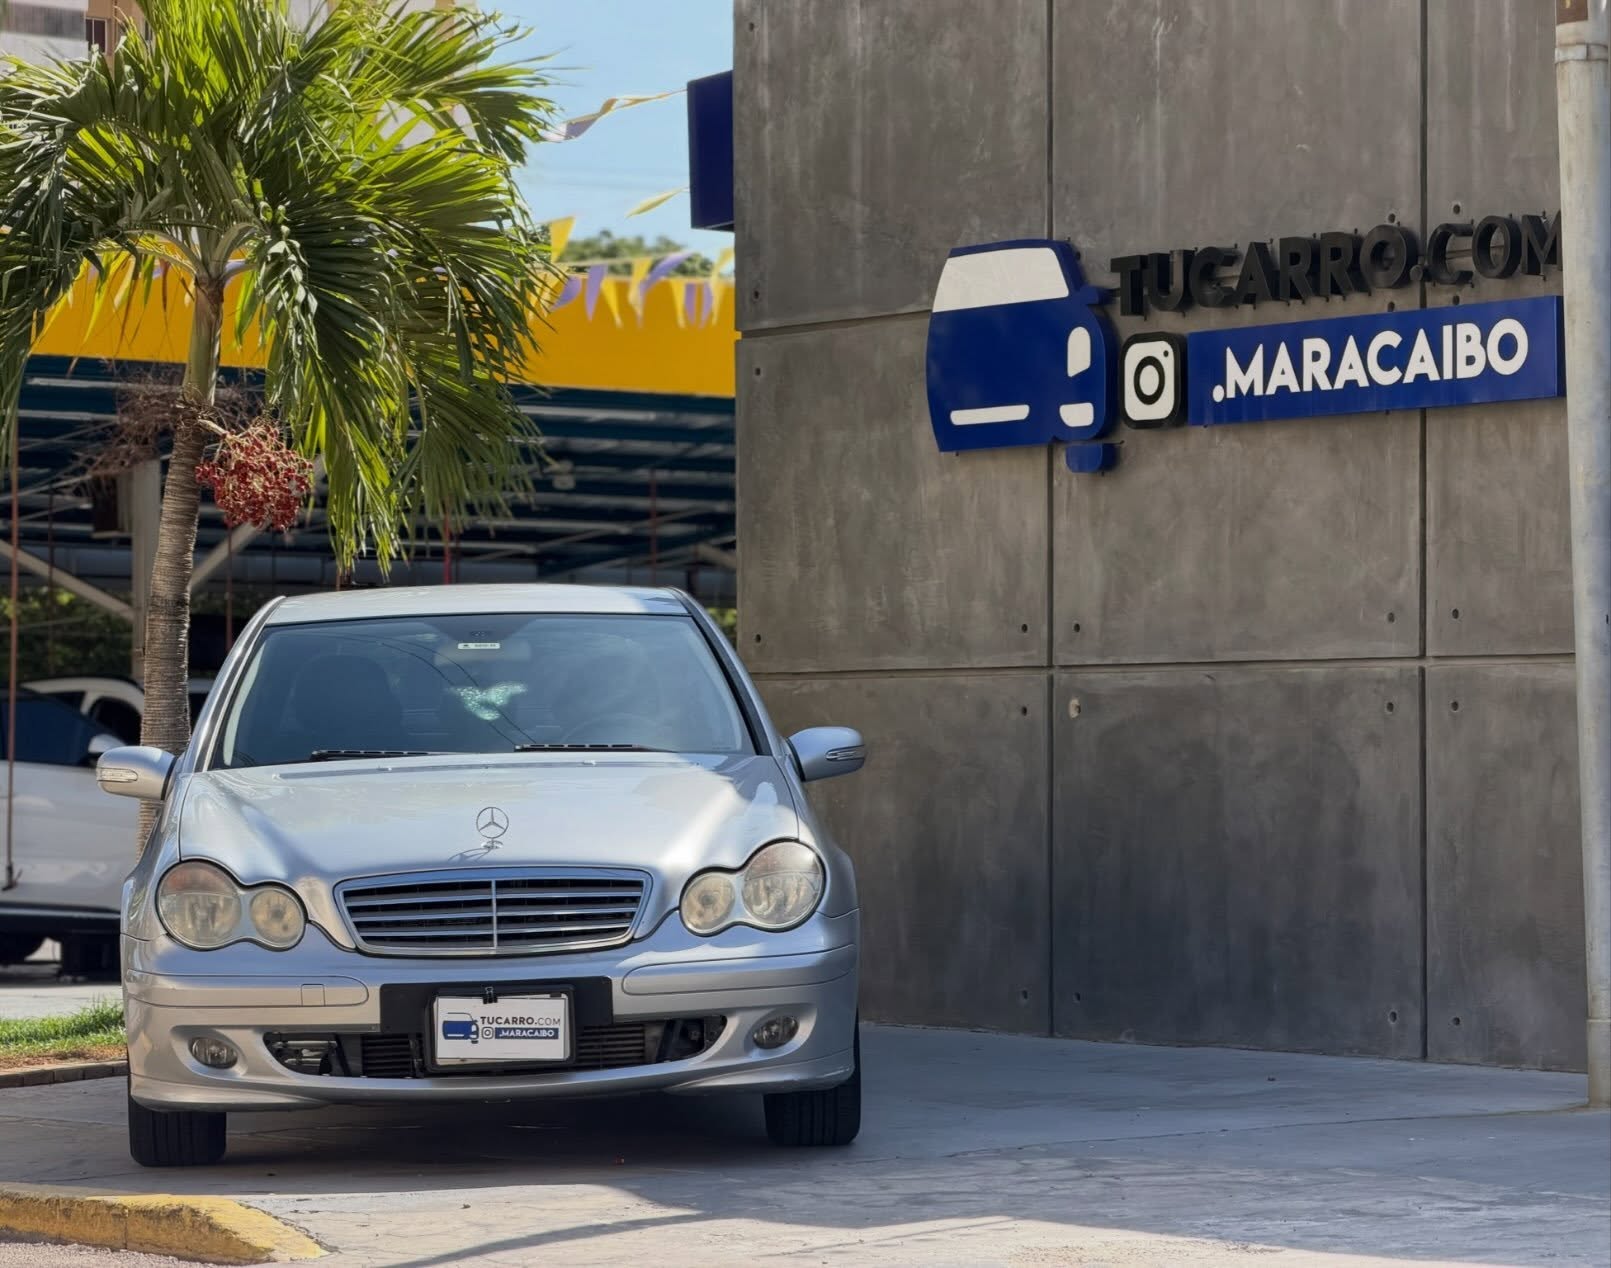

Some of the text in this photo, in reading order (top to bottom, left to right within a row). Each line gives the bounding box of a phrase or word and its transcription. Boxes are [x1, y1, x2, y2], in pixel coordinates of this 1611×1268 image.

[1110, 212, 1563, 316] TUCARRO.COM
[1212, 318, 1529, 403] .MARACAIBO
[480, 1016, 561, 1026] TUCARRO.COM
[498, 1028, 555, 1037] .MARACAIBO
